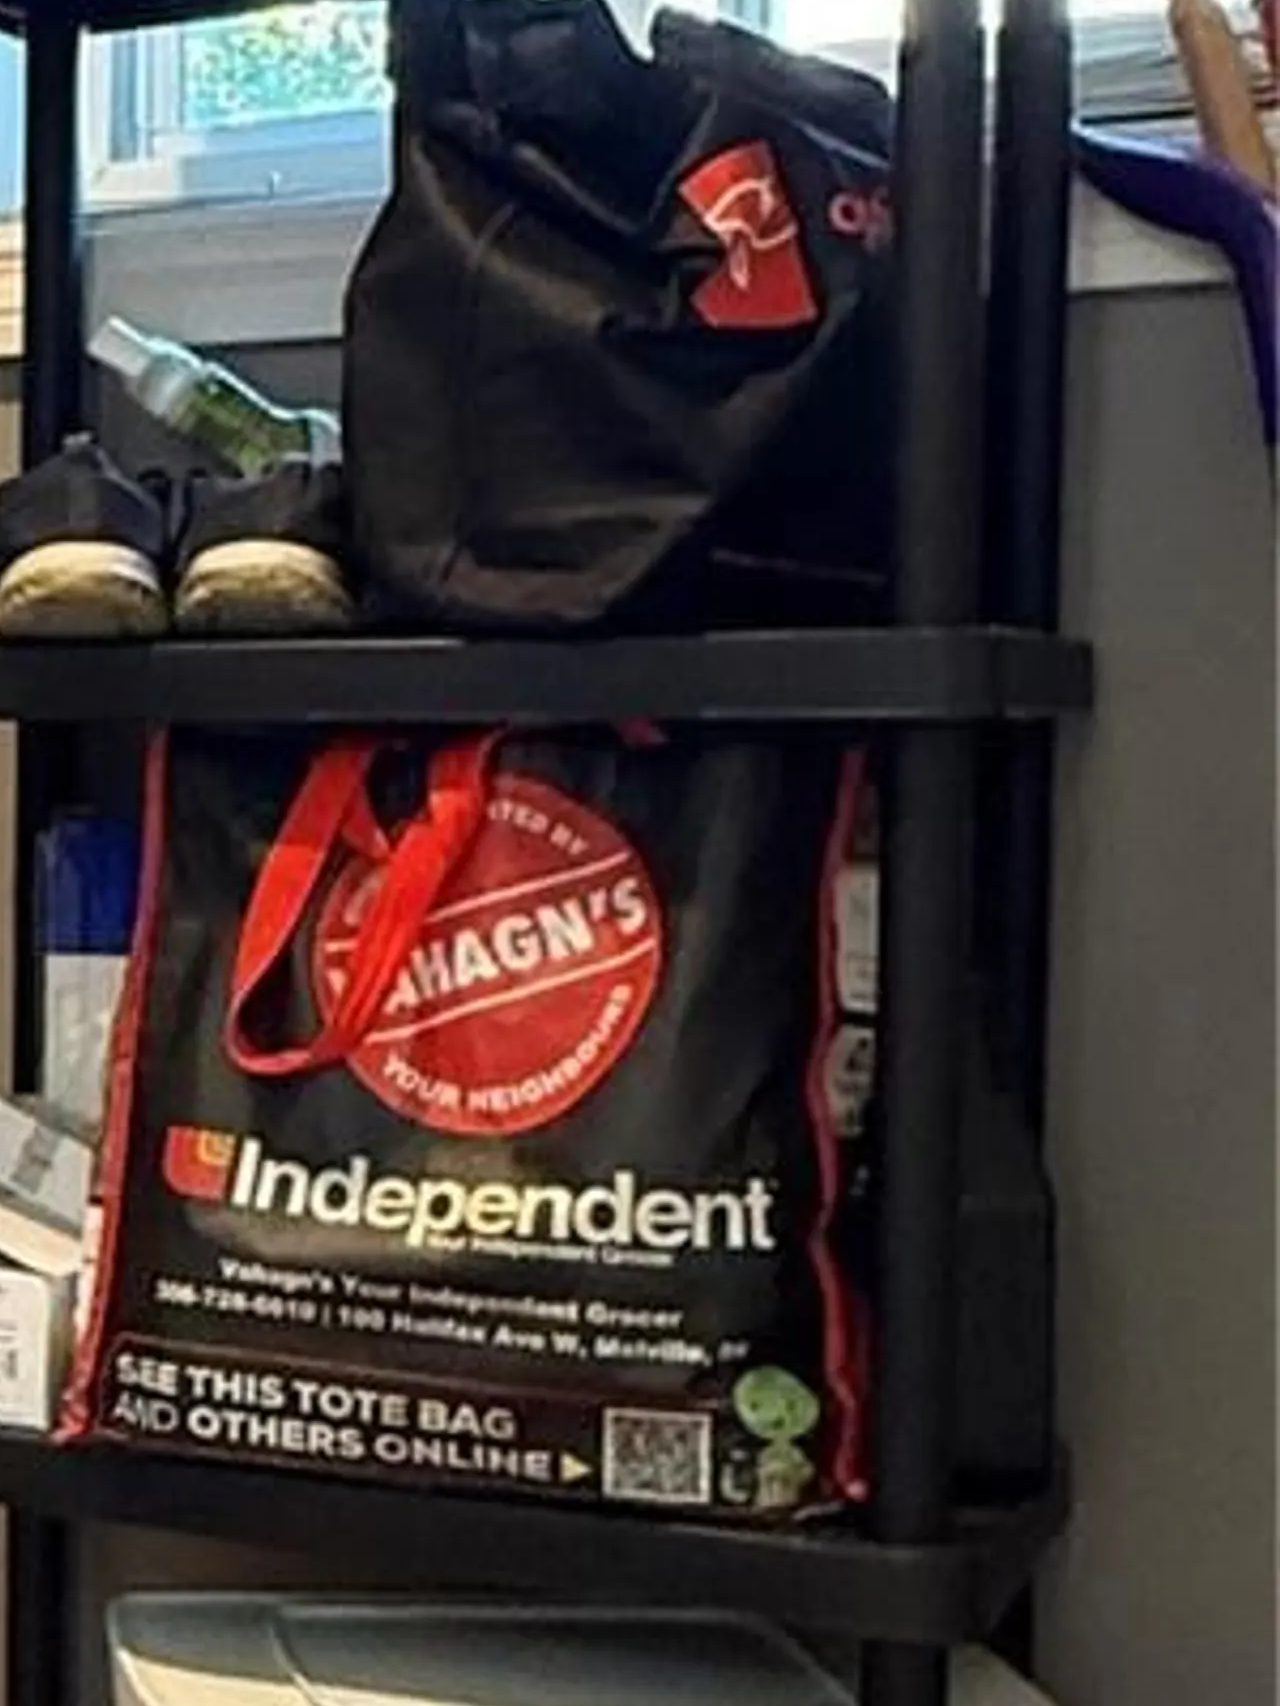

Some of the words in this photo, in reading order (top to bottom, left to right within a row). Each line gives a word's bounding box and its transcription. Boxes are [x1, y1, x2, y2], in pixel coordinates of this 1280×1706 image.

[383, 1051, 461, 1111] YOUR
[231, 1136, 777, 1250] Independent
[408, 1283, 579, 1323] Independent
[585, 1301, 685, 1328] Grocer
[493, 1325, 545, 1351] Ave
[115, 1353, 178, 1396] SEE
[185, 1365, 285, 1409] THIS
[292, 1379, 408, 1428] TOTE
[418, 1399, 516, 1440] BAG
[114, 1391, 181, 1433] AND
[187, 1406, 365, 1460] OTHERS
[373, 1432, 552, 1482] ONLINE
